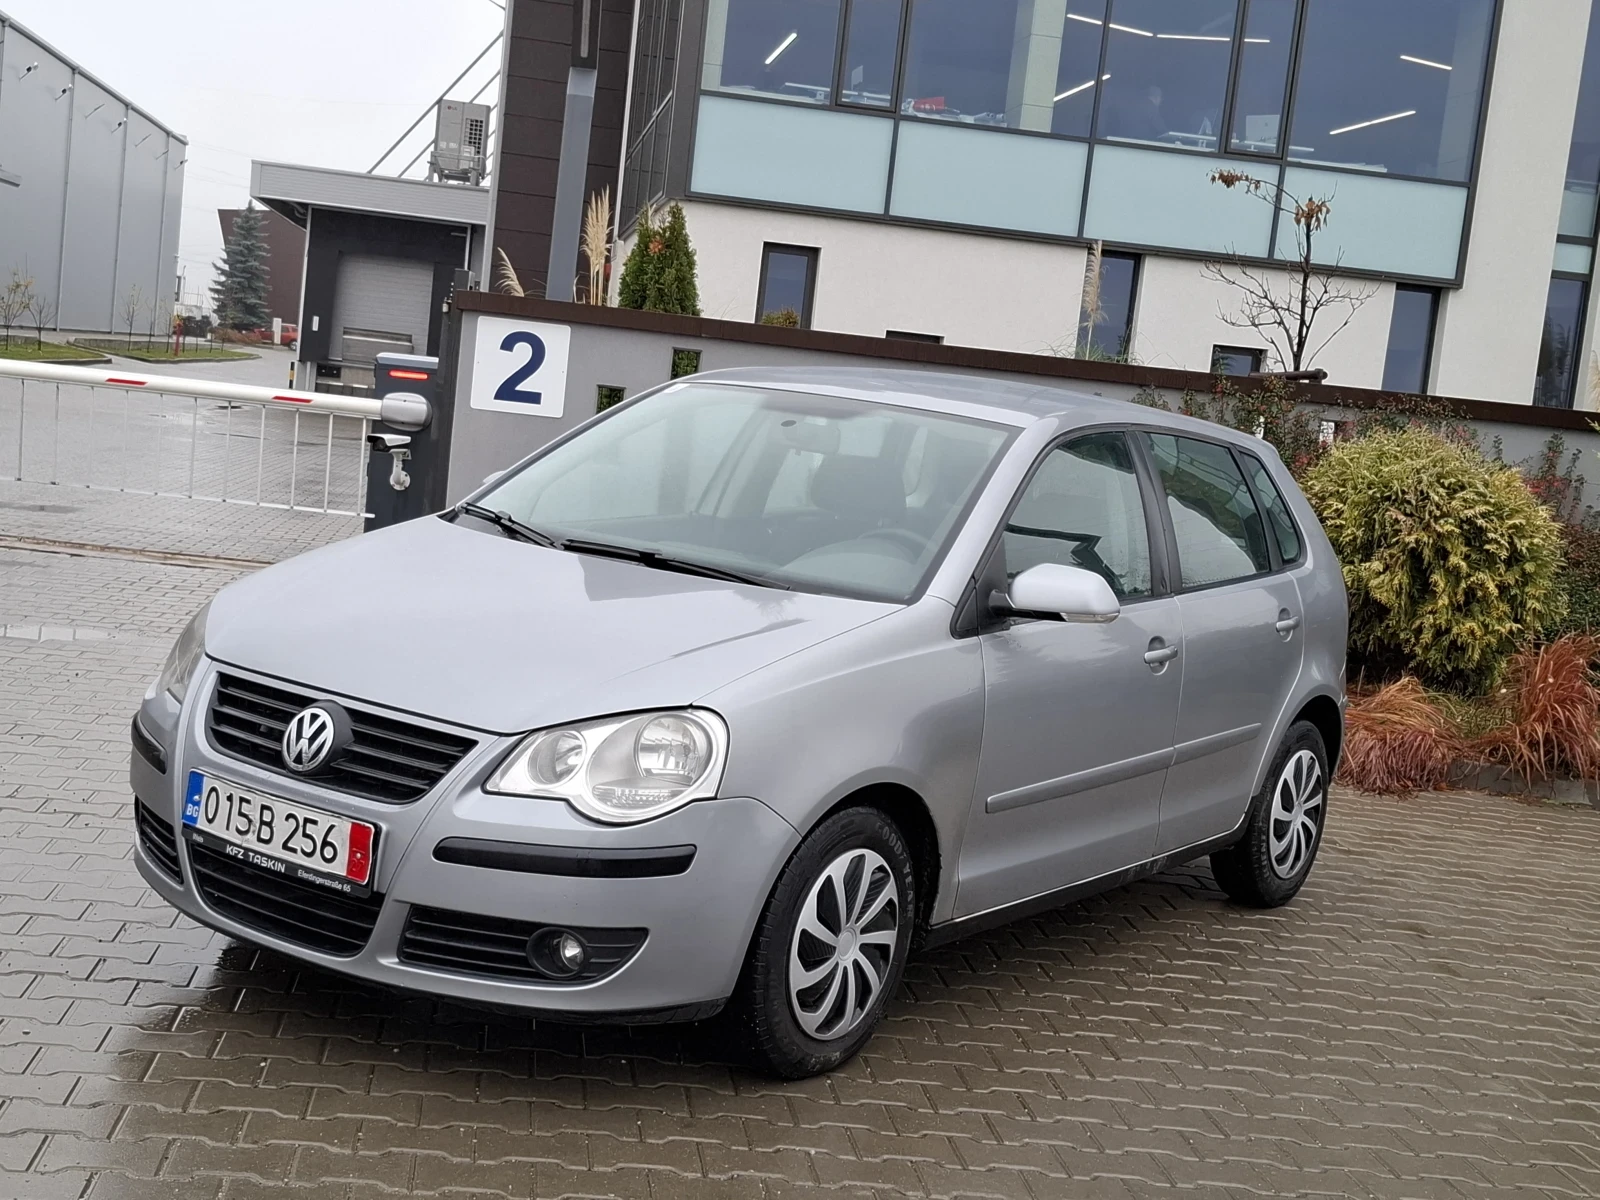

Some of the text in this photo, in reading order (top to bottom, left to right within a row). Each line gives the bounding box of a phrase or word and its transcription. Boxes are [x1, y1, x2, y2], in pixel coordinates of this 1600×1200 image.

[493, 330, 546, 406] 2
[282, 708, 335, 772] VW
[186, 803, 200, 818] BG
[226, 844, 287, 874] KFZ TASKIN
